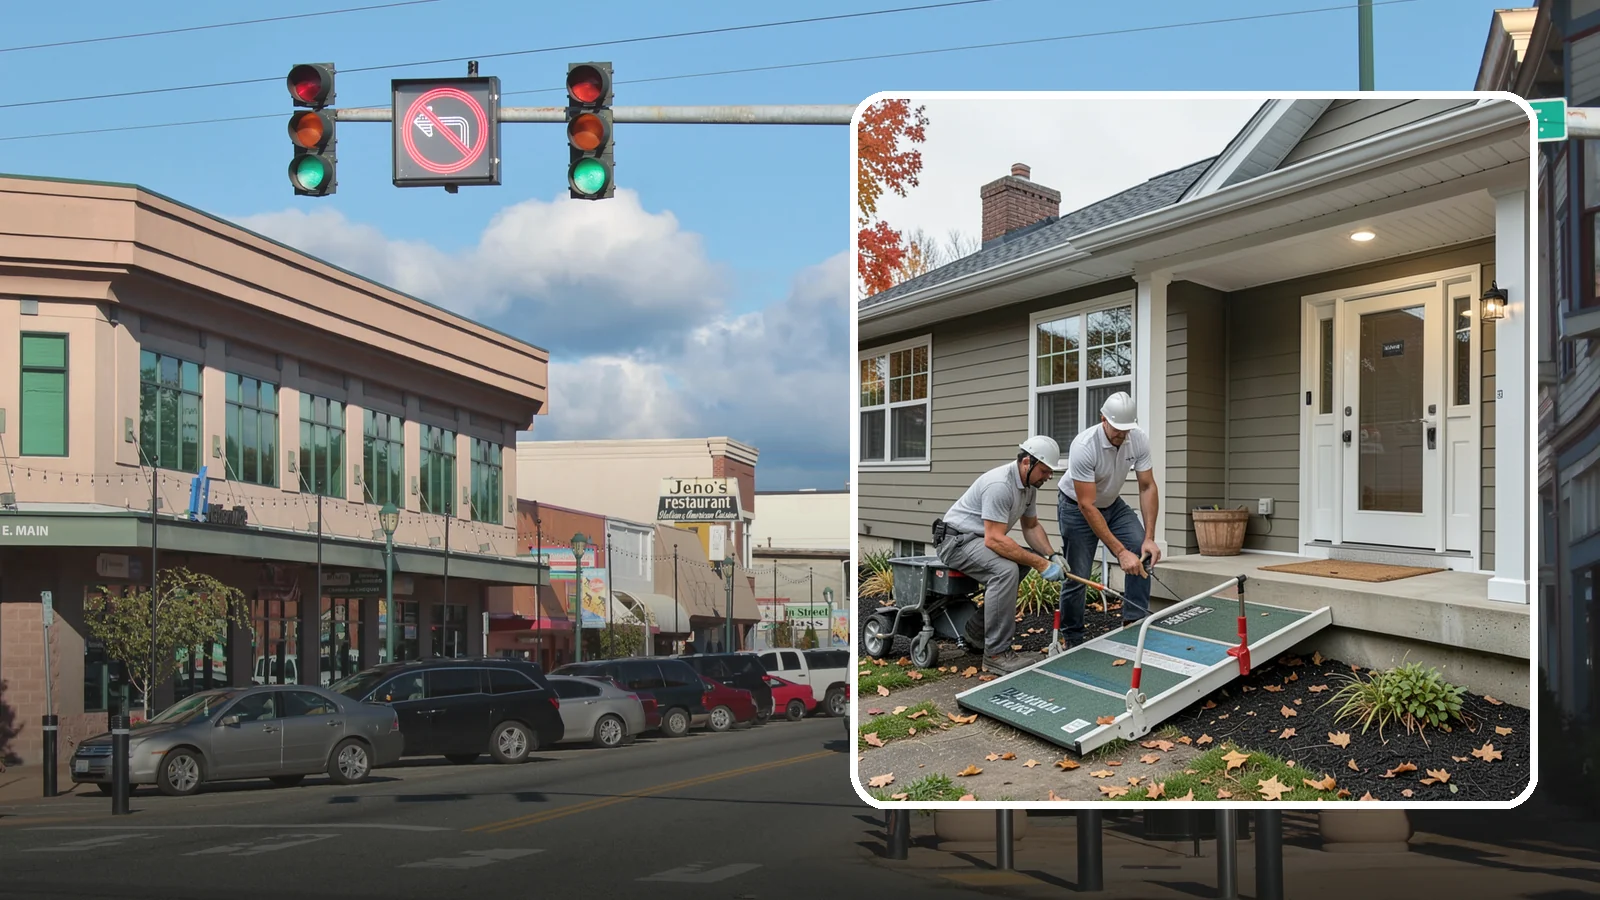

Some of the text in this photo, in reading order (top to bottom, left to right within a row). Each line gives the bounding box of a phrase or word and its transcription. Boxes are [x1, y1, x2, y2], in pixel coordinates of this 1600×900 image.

[669, 480, 727, 494] Jeno's
[665, 496, 731, 509] restaurant
[685, 510, 715, 519] American
[714, 509, 737, 519] Cuisine
[2, 525, 49, 536] E. MAIN
[798, 608, 828, 616] Street
